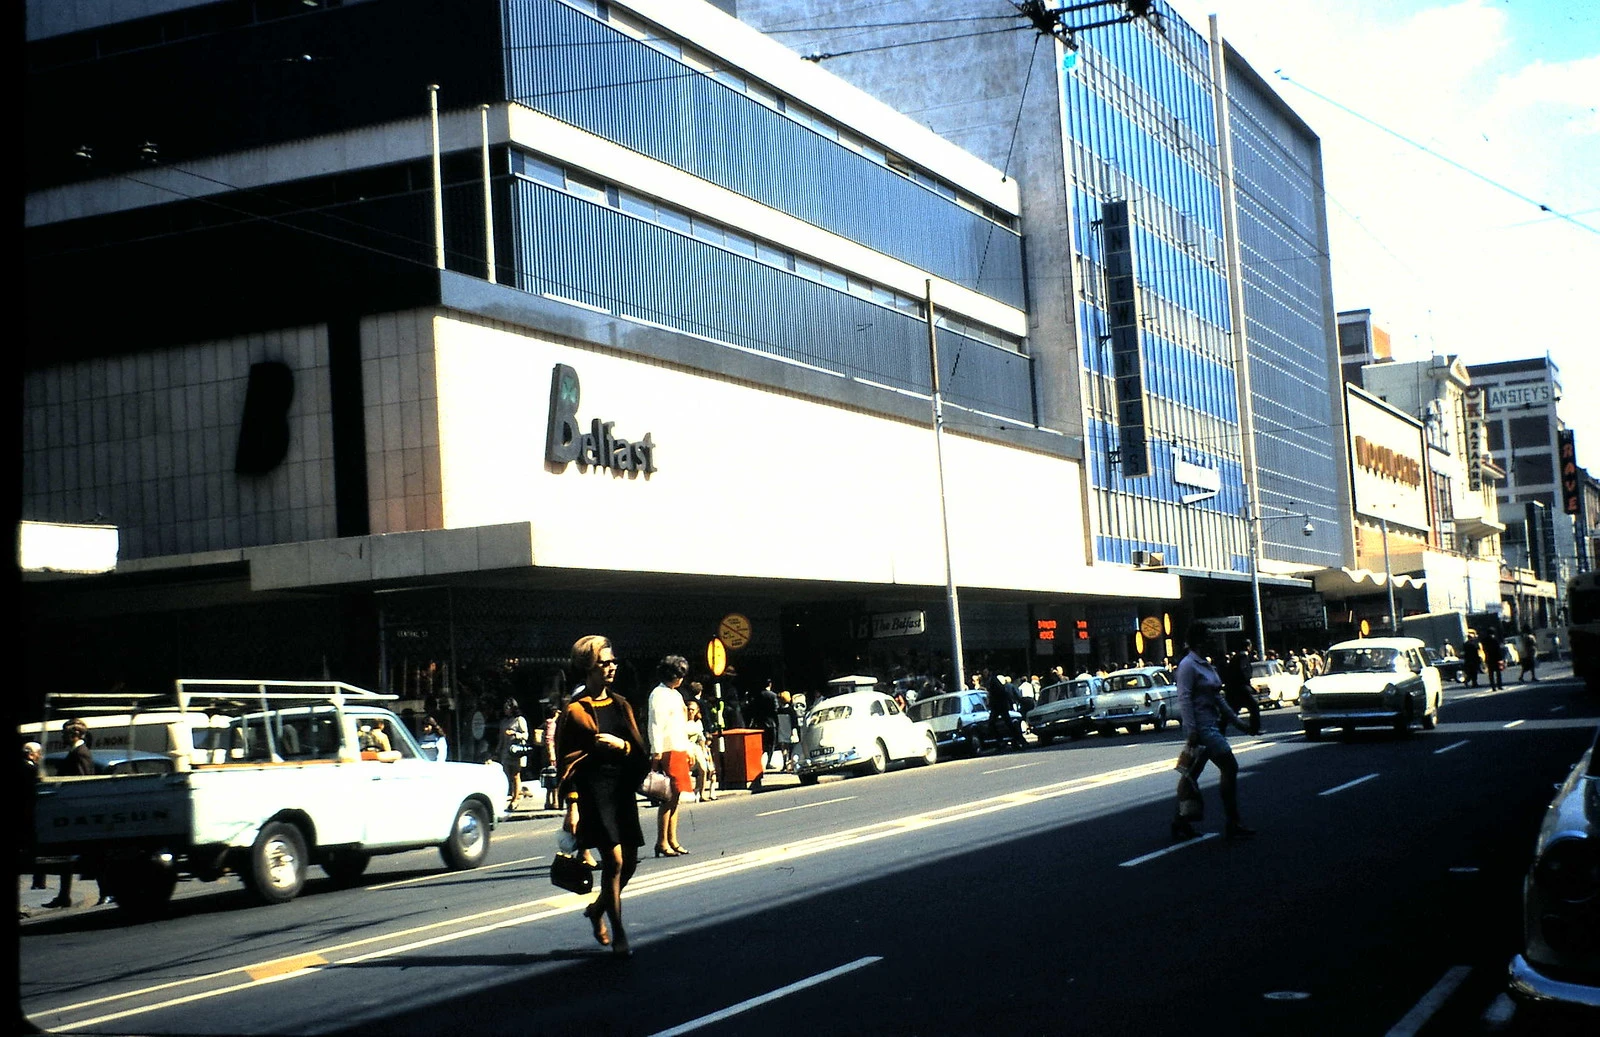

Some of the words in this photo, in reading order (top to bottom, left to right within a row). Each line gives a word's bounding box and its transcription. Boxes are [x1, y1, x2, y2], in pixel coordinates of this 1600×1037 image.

[1109, 204, 1139, 476] UNIEWINKELS
[1491, 385, 1550, 405] ANSTEY'S
[544, 362, 657, 473] Belfast
[1470, 421, 1481, 489] BAZAARS
[873, 618, 891, 631] The
[891, 616, 921, 633] Belfast
[53, 810, 169, 828] DATSUN
